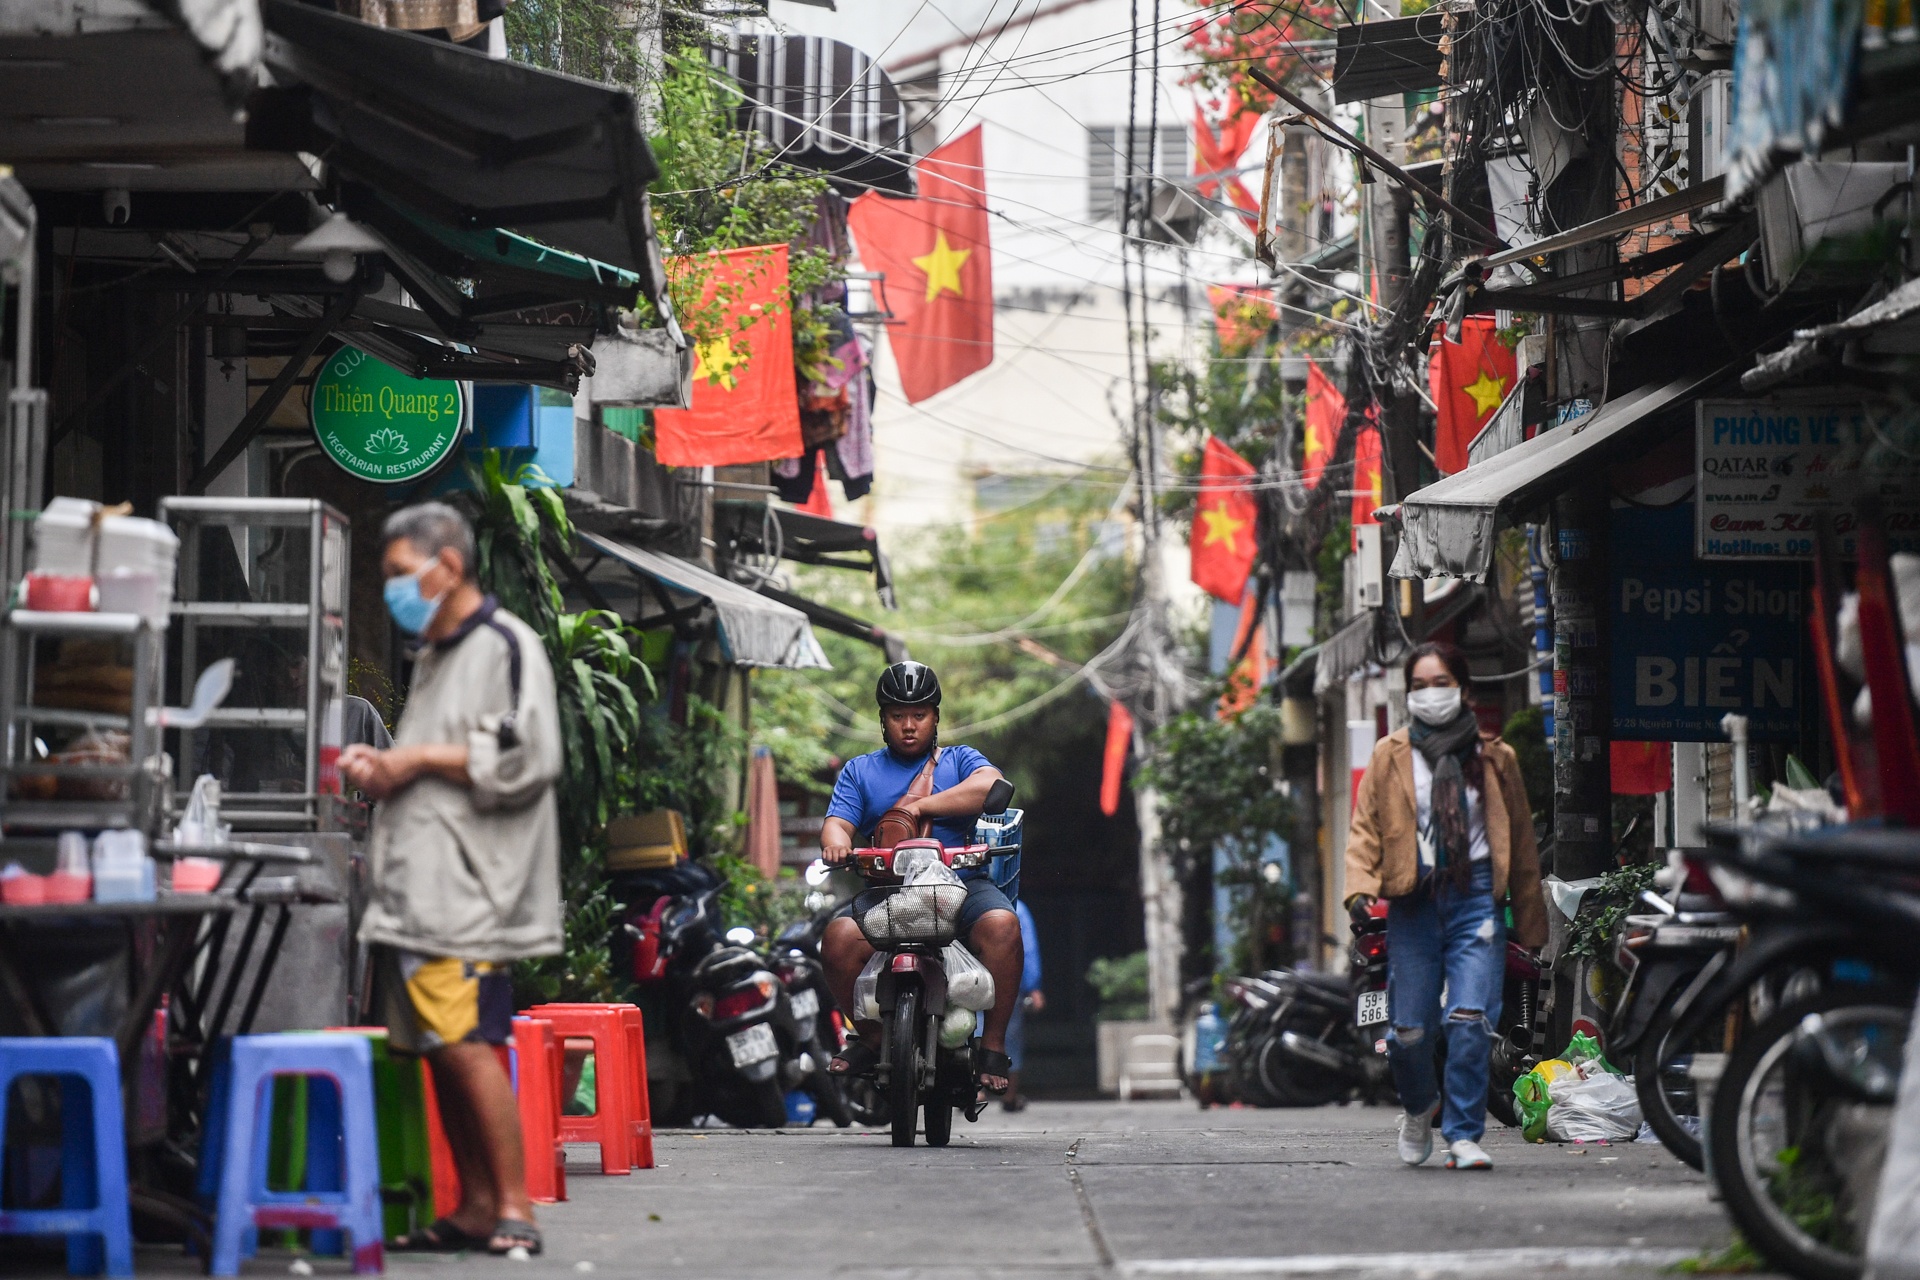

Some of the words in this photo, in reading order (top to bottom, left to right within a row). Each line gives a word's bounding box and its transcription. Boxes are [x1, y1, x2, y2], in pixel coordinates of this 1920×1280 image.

[322, 384, 374, 417] Thiện
[379, 386, 439, 422] Quang
[443, 393, 455, 415] 2
[326, 430, 382, 475] VEGETARIAN
[386, 432, 447, 475] RESTAURANT
[1703, 457, 1768, 475] QATAR
[1705, 494, 1732, 502] EVA
[1734, 494, 1758, 502] AIR
[1707, 538, 1780, 554] Hotline:
[1621, 578, 1711, 620] Pepsi
[1723, 579, 1801, 621] Shop
[1635, 629, 1794, 708] BIỂN
[1674, 718, 1702, 730] Trung
